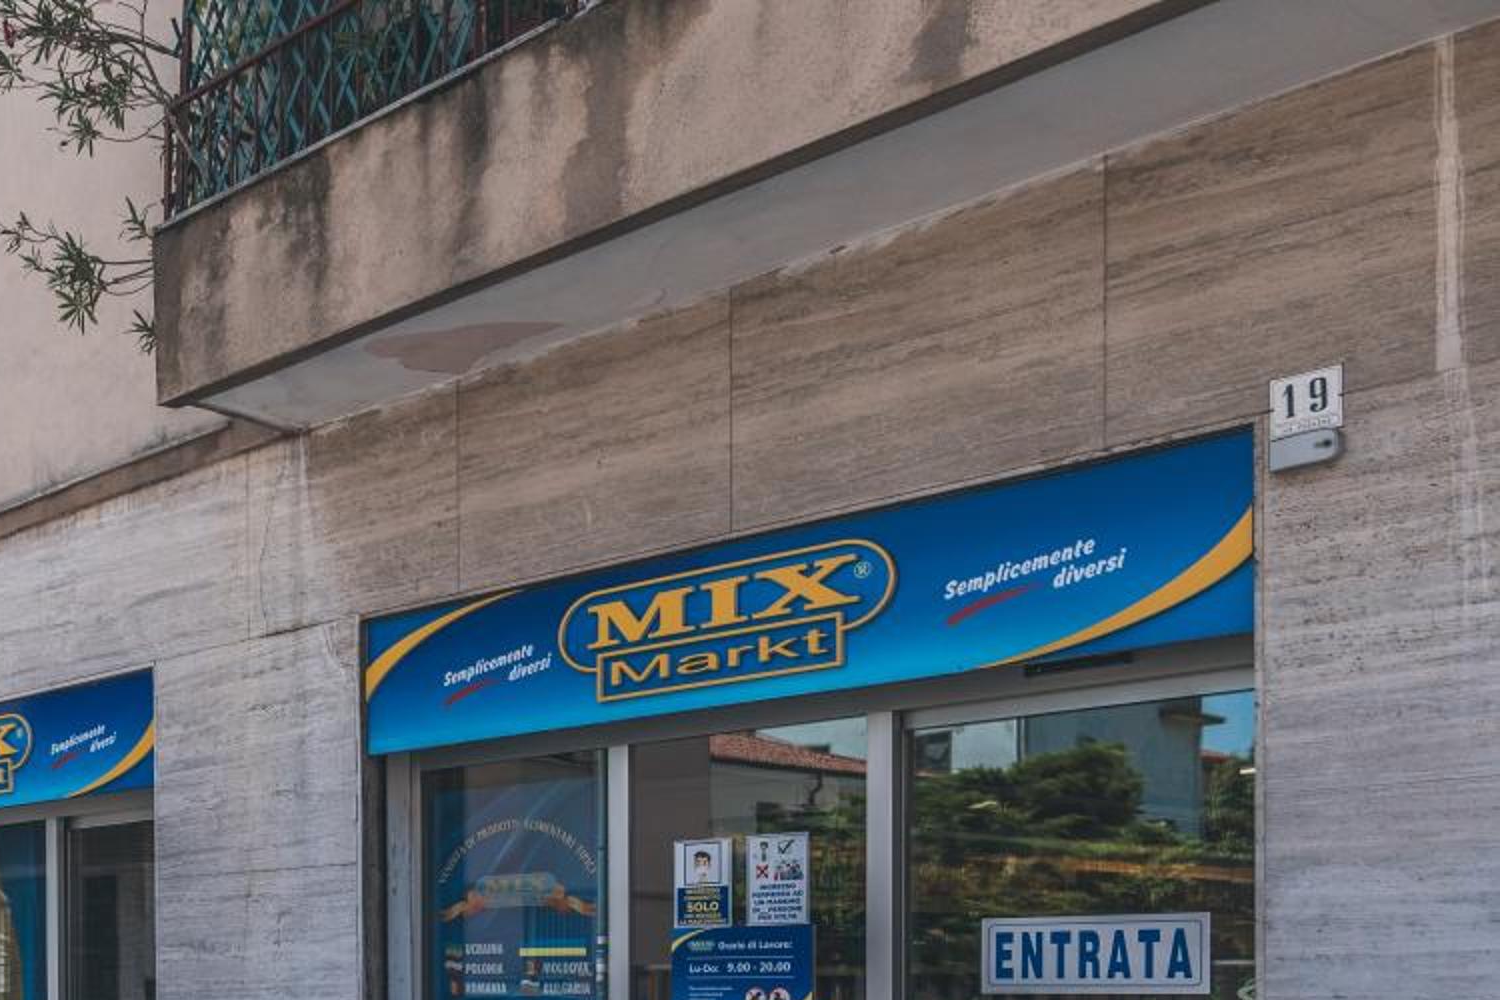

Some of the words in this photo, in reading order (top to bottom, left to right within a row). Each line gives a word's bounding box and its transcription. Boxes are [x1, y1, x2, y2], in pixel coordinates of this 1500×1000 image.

[1283, 377, 1327, 418] 19
[943, 538, 1096, 600] Semplicemente
[1052, 547, 1127, 589] diversi
[586, 553, 861, 649] MIX
[443, 644, 534, 687] Semplicemente
[508, 652, 552, 681] diversi
[610, 628, 828, 687] Markt
[686, 901, 719, 913] SOLO
[747, 941, 756, 949] di
[994, 927, 1193, 979] ENTRATA
[726, 962, 751, 973] 9.00
[759, 961, 791, 972] 20.00
